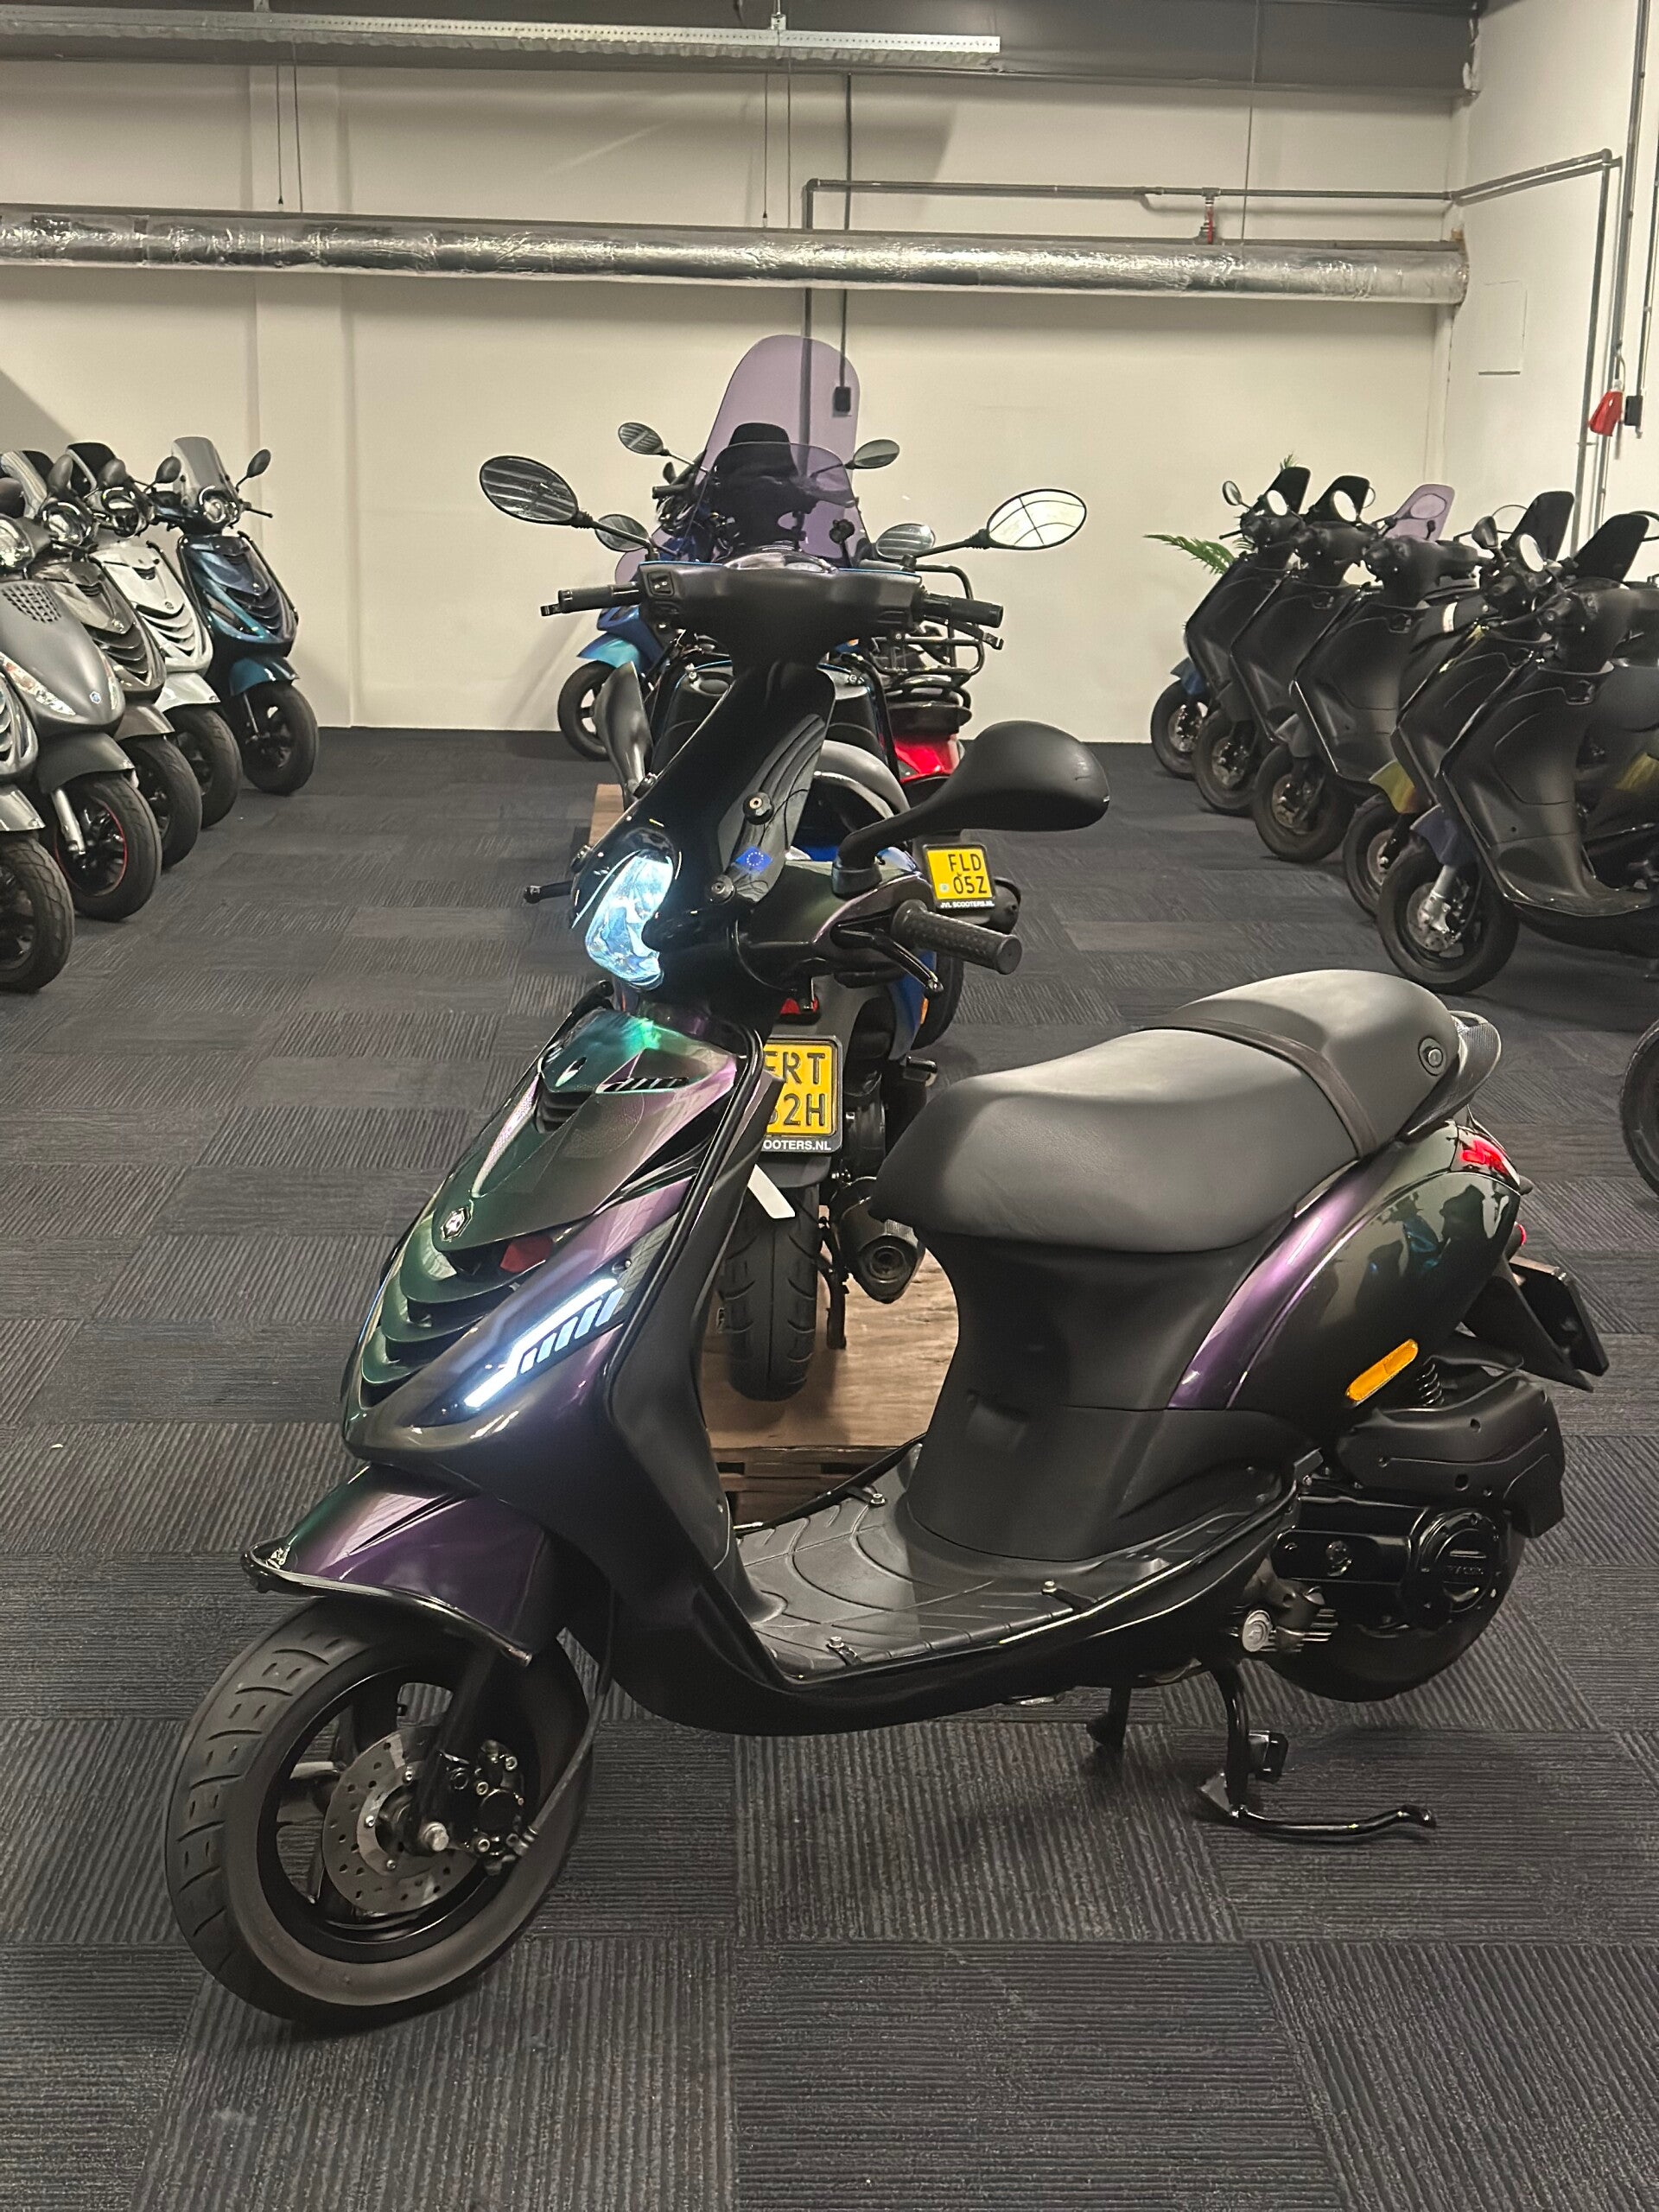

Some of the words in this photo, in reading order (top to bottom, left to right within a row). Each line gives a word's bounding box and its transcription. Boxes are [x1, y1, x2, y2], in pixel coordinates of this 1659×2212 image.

[948, 854, 982, 872] FLD
[953, 875, 987, 894] 05Z
[762, 1140, 831, 1151] OOTERS.NL
